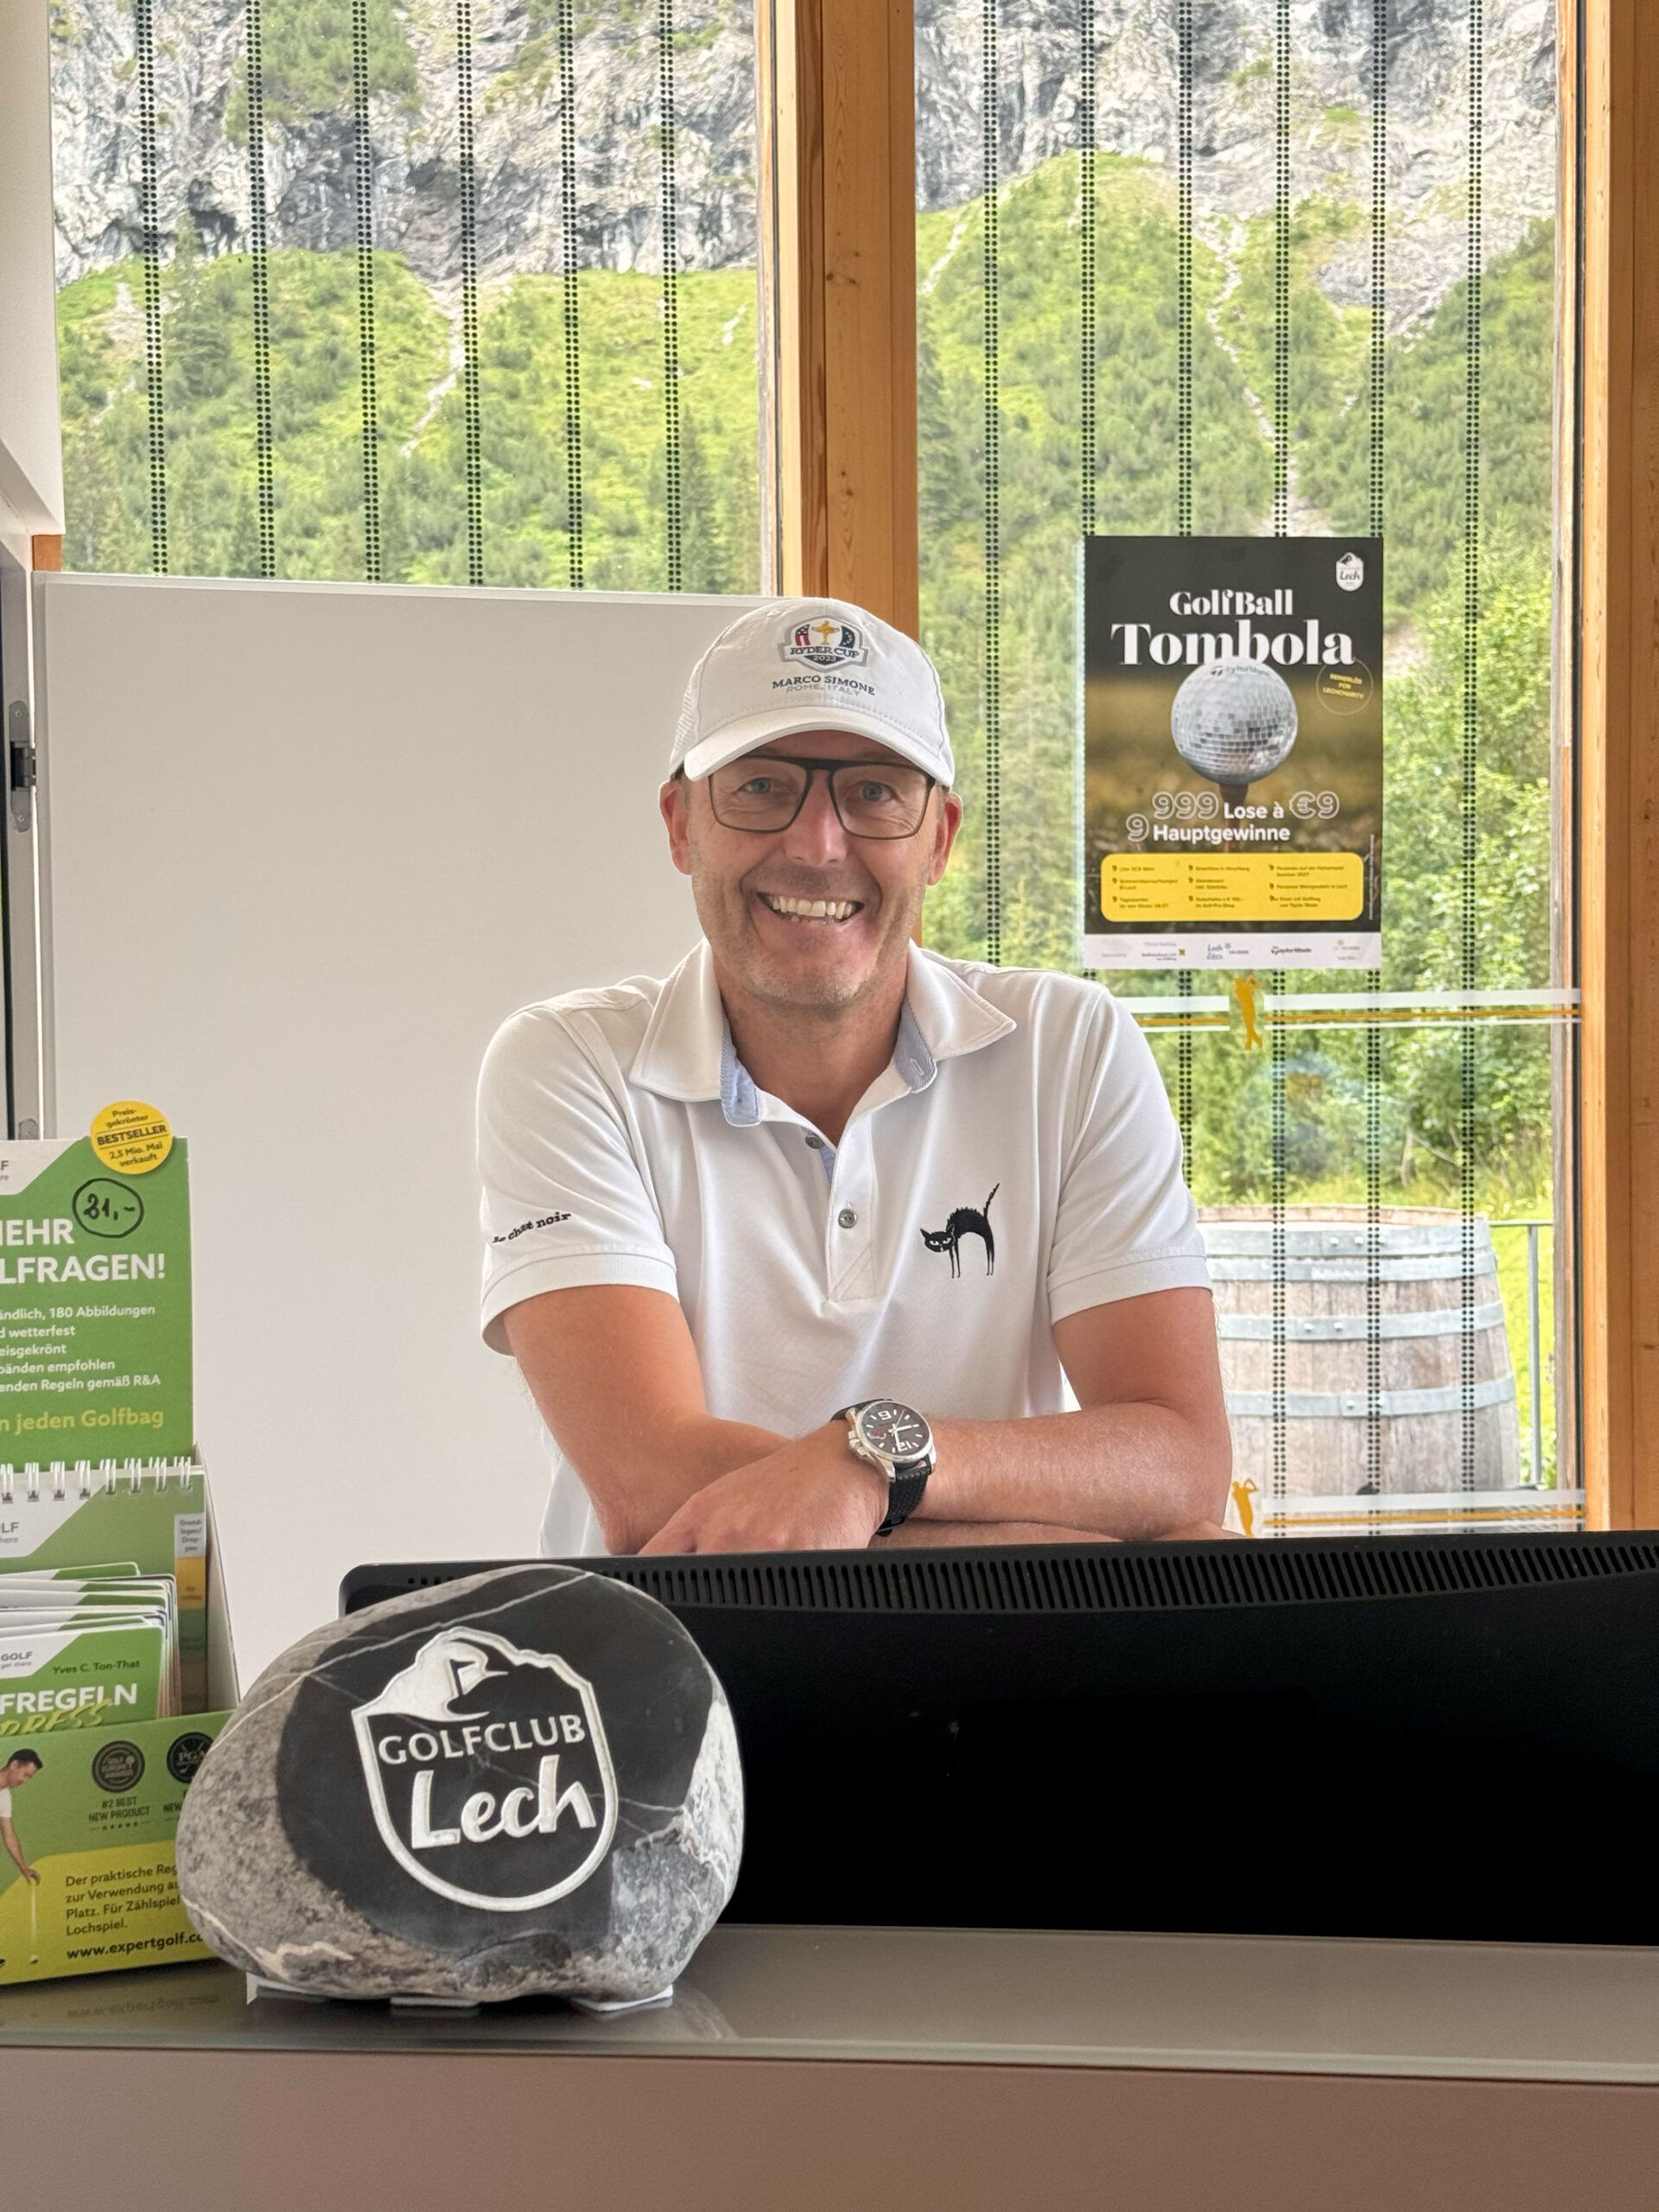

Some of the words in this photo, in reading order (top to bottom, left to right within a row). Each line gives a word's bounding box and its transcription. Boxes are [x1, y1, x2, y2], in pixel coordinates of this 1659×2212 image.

[1169, 588, 1294, 615] GolfBall
[1110, 619, 1356, 665] Tombola
[790, 646, 832, 655] RYDER
[834, 648, 860, 658] CUP
[772, 675, 822, 689] MARCO
[824, 676, 875, 696] SIMONE
[828, 685, 861, 696] ITALY
[1152, 791, 1219, 820] 999
[1224, 803, 1268, 819] Lose
[1273, 801, 1284, 818] à
[1289, 791, 1339, 819] €9
[1126, 813, 1149, 842] 9
[1154, 824, 1290, 844] Hauptgewinne
[106, 1115, 149, 1128] gekrönter
[111, 1109, 137, 1117] Preis-
[97, 1124, 167, 1146] BESTSELLER
[125, 1147, 145, 1155] Mio.
[146, 1141, 162, 1151] Mal
[119, 1153, 158, 1166] verkauft
[0, 1218, 74, 1246] EHR
[508, 1221, 534, 1240] chat
[536, 1211, 571, 1228] noir
[49, 1306, 73, 1319] 180
[76, 1306, 156, 1319] Abbildungen
[9, 1325, 76, 1338] wetterfest
[48, 1359, 116, 1374] empfohlen
[41, 1377, 84, 1392] Regeln
[87, 1376, 130, 1390] gemäß
[133, 1374, 161, 1386] R&A
[15, 1411, 75, 1435] jeden
[80, 1407, 164, 1428] Golfbag
[1, 1651, 34, 1661] GOLF
[53, 1666, 78, 1675] Yves
[93, 1660, 140, 1671] Ton-That
[378, 1714, 586, 1764] GOLFCLUB
[116, 1796, 138, 1807] BEST
[411, 1754, 597, 1849] Lech
[88, 1811, 109, 1821] NEW
[111, 1806, 150, 1819] PRODUCT
[66, 1875, 88, 1887] Der
[91, 1866, 153, 1886] praktische
[66, 1892, 86, 1904] zur
[87, 1883, 164, 1900] Verwendung
[66, 1908, 99, 1920] Platz.
[104, 1903, 123, 1915] Für
[125, 1894, 180, 1912] Zählspiel
[67, 1918, 128, 1936] Lochspiel.
